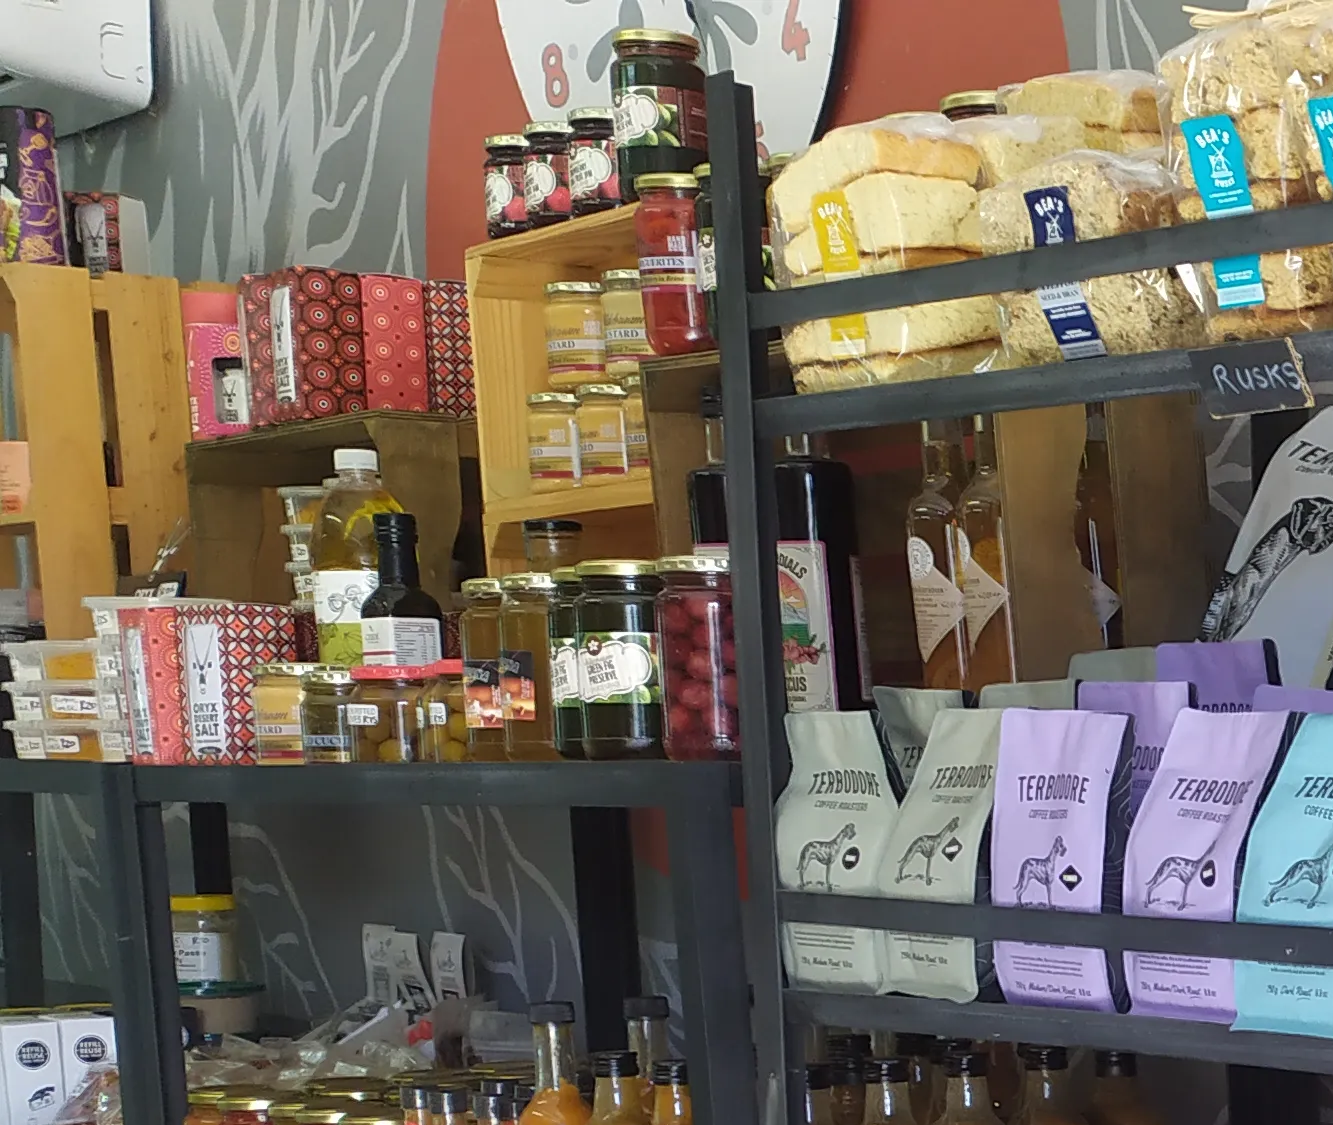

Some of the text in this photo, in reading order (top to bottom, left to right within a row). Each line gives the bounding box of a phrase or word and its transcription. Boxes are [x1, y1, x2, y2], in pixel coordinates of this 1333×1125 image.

[542, 43, 570, 108] 8
[1195, 128, 1230, 148] BEA'S
[1034, 196, 1063, 217] BEA'S
[605, 661, 614, 673] FIG
[193, 703, 218, 714] ORYX
[193, 714, 219, 724] DESERT
[195, 723, 220, 737] SALT
[808, 768, 882, 798] TERBODORE
[1017, 774, 1090, 805] TERBODORE
[1303, 804, 1333, 820] COFFEE
